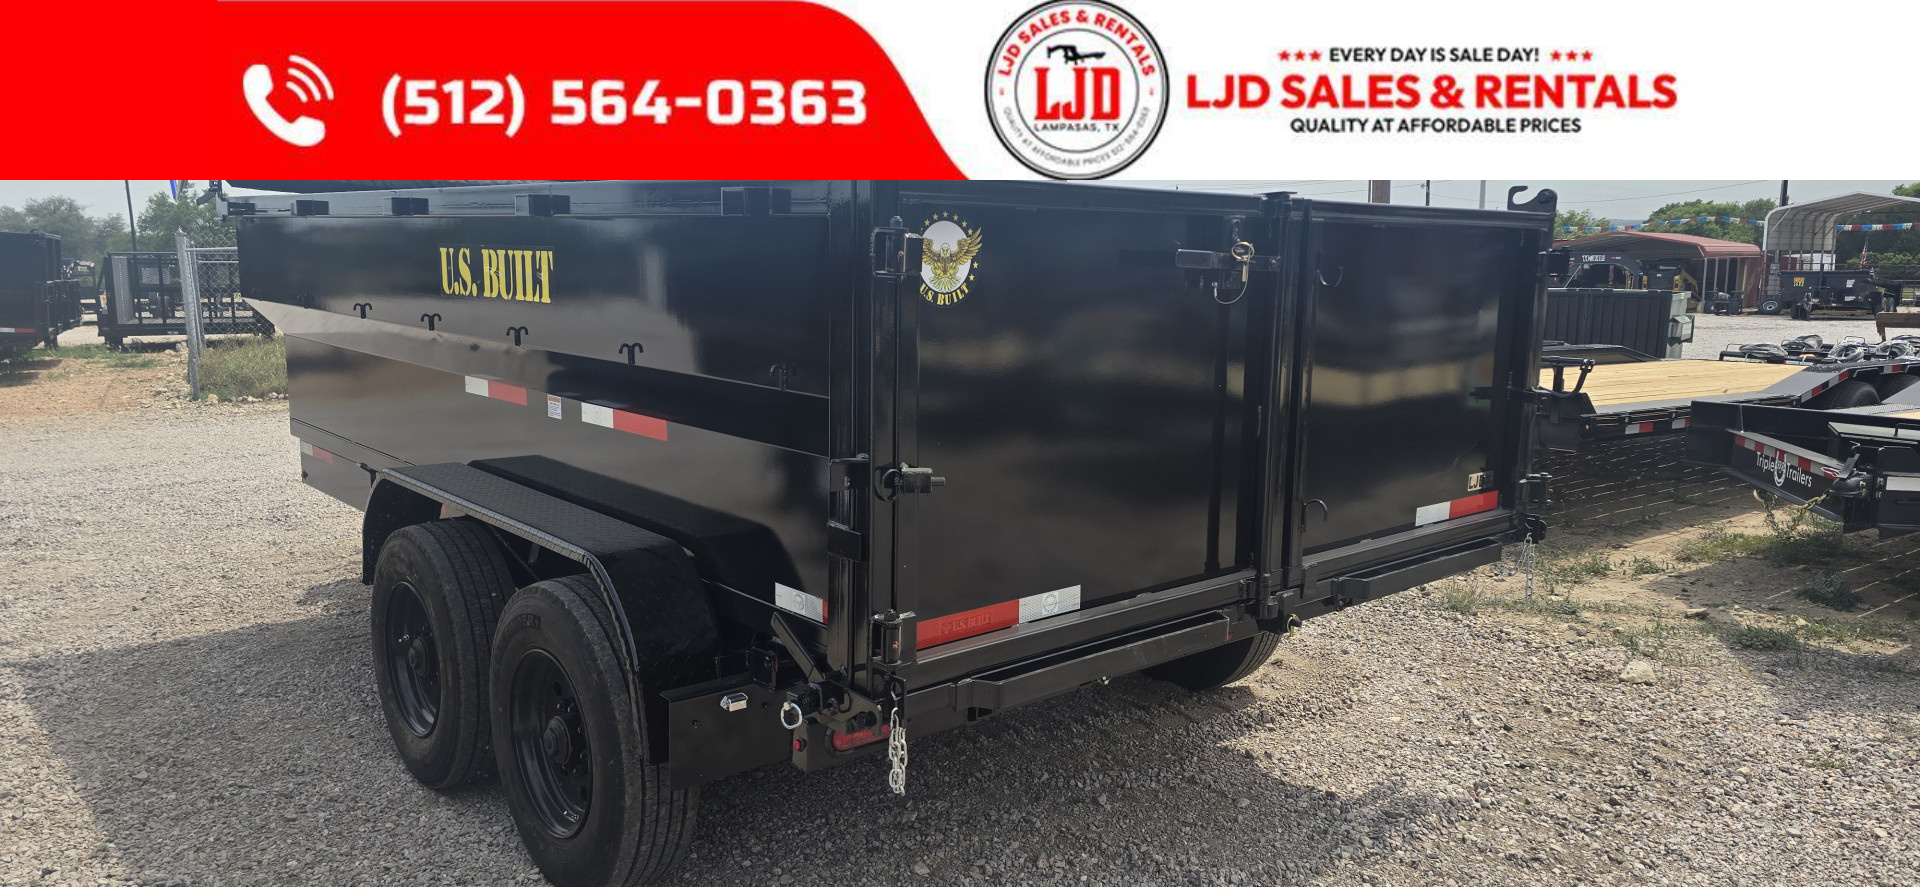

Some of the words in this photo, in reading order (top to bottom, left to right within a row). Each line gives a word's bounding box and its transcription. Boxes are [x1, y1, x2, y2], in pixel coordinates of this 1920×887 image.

[439, 247, 478, 297] U.S.
[481, 249, 554, 303] BUILT
[919, 283, 935, 303] U.S.
[936, 283, 969, 305] BUILT
[1756, 451, 1775, 473] Triple
[1786, 462, 1813, 488] Trailers
[967, 613, 992, 629] BUILT
